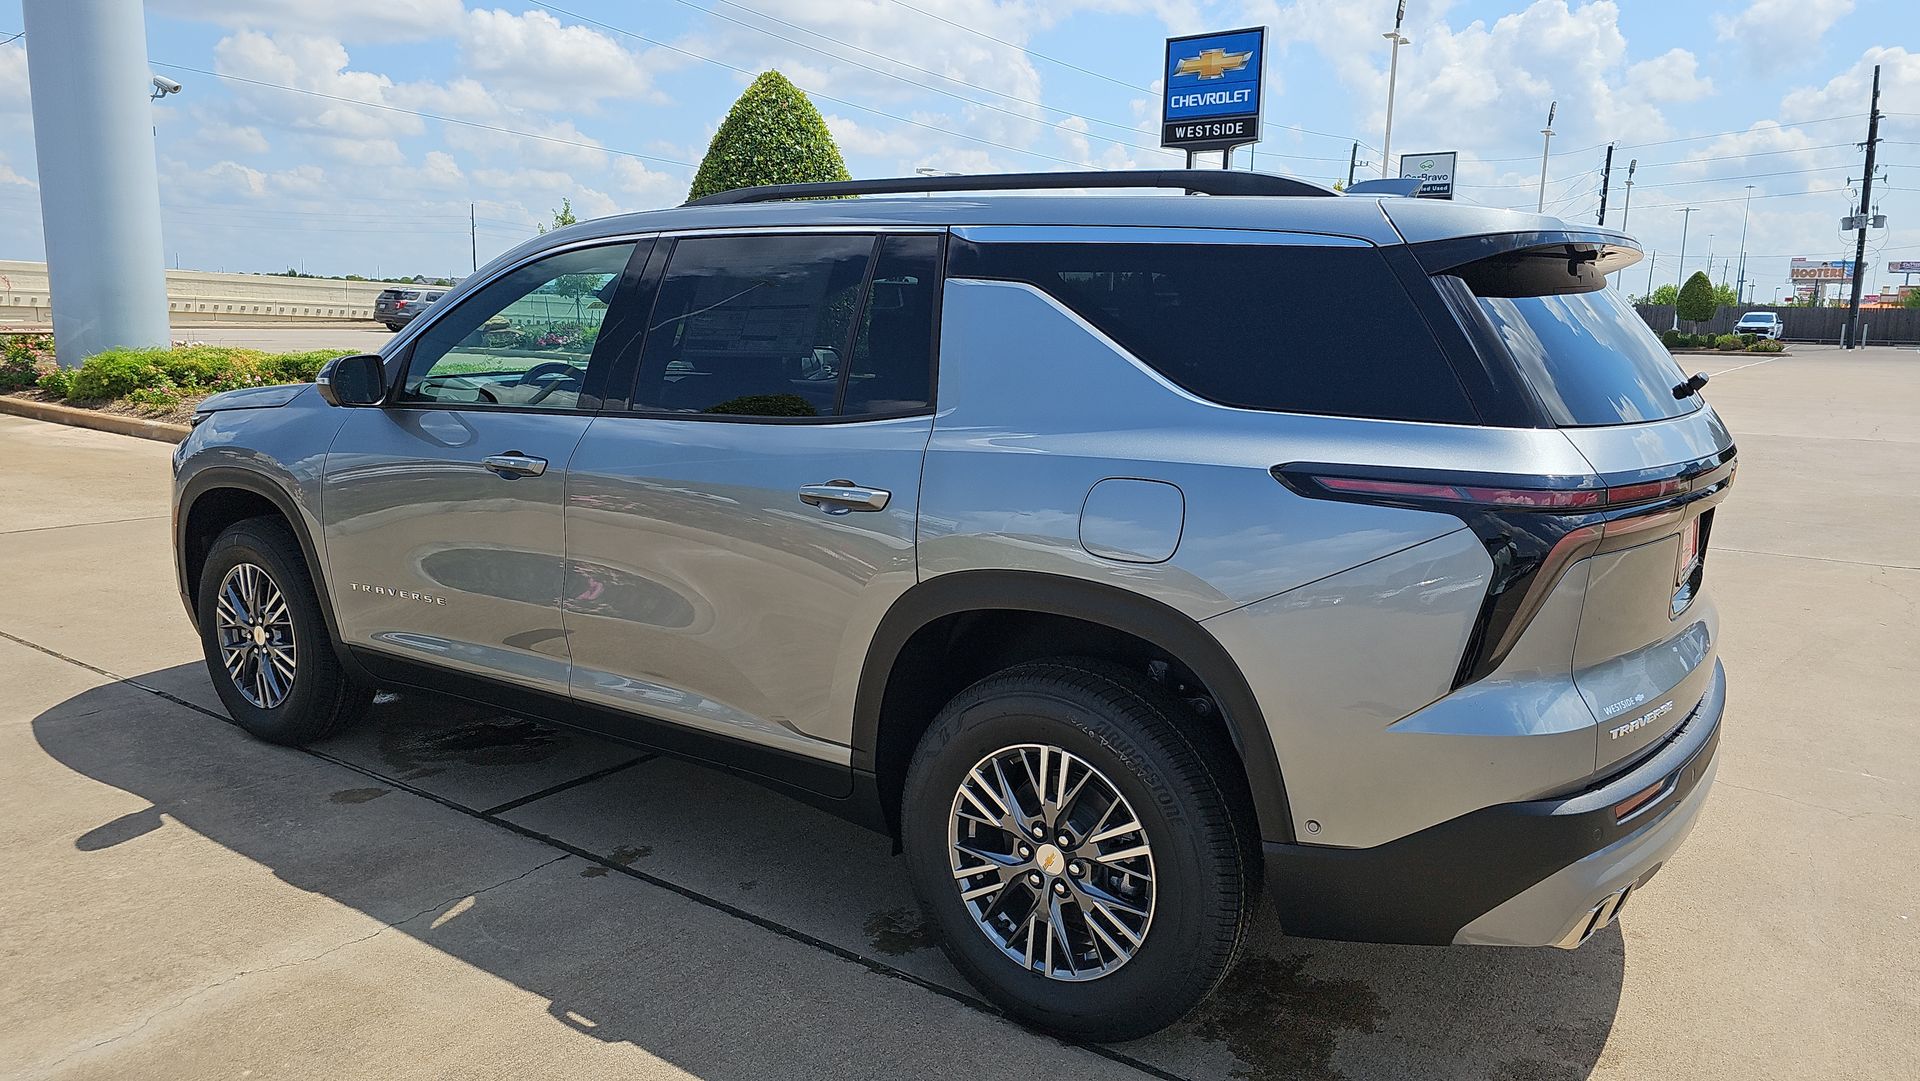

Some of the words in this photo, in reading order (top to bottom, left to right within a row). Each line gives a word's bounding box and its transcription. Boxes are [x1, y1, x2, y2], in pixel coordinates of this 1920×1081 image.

[1171, 88, 1252, 109] CHEVROLET
[1175, 121, 1244, 139] WESTSIDE
[1791, 268, 1844, 278] HOOTERS
[350, 582, 447, 606] TRAVERSE
[1603, 697, 1636, 716] WESTSIDE
[1609, 700, 1674, 740] TRAVERSE
